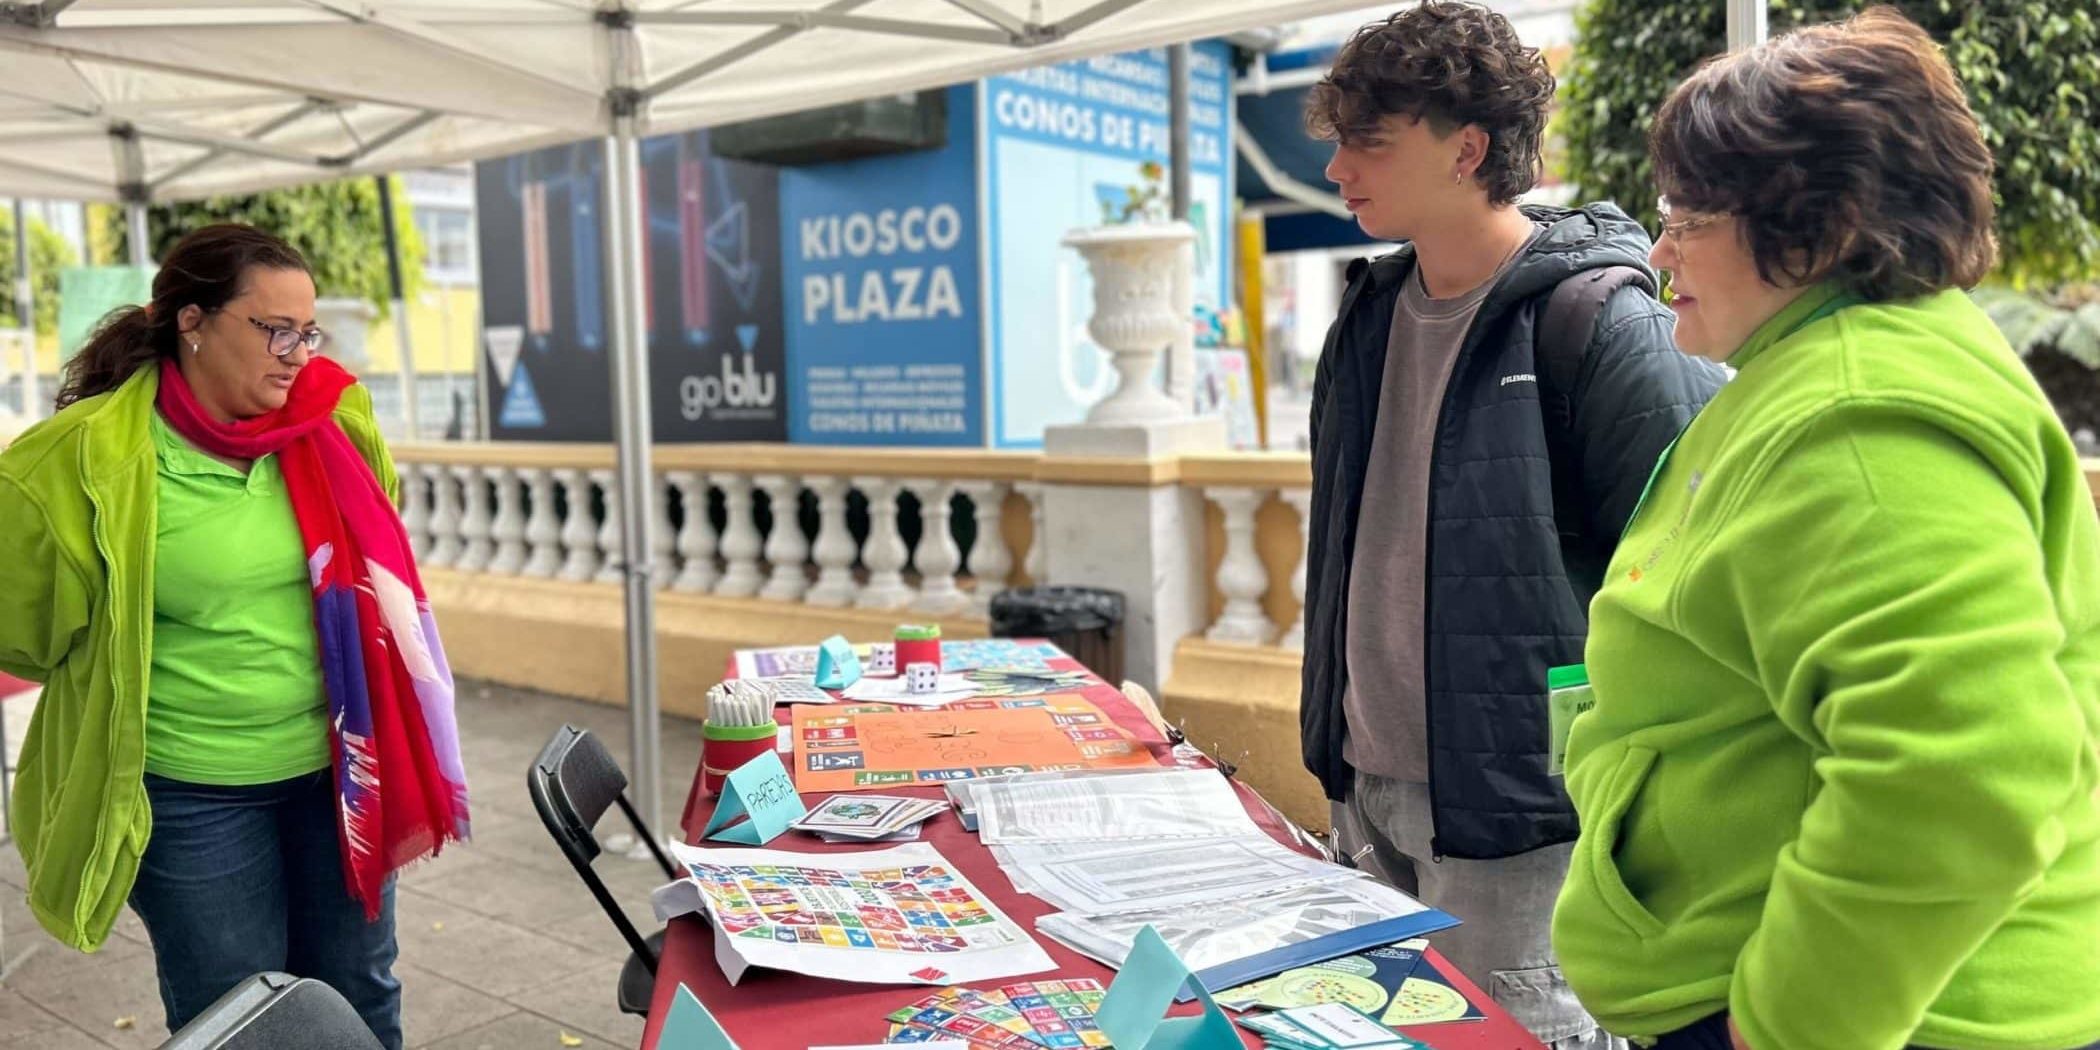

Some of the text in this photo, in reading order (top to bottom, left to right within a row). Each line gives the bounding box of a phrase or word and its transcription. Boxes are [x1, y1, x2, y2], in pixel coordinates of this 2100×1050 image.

[995, 91, 1097, 141] CONOS
[1102, 113, 1134, 149] DE
[802, 204, 961, 260] KIOSCO
[804, 267, 962, 324] PLAZA
[809, 412, 868, 432] CONOS
[872, 412, 895, 432] DE
[747, 774, 793, 812] PAREJAS
